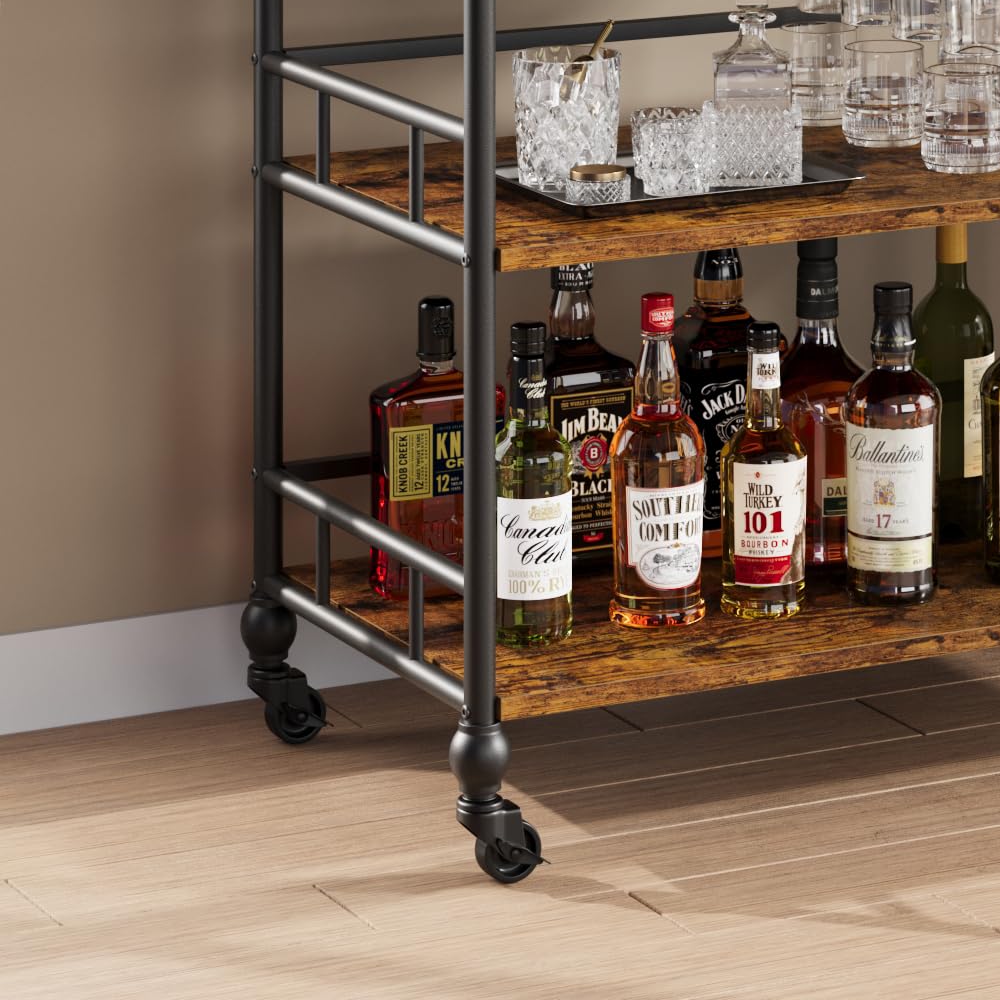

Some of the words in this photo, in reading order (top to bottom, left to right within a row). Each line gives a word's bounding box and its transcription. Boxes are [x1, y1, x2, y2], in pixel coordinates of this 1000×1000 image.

[701, 390, 734, 420] JACK
[561, 414, 586, 443] JIM
[398, 435, 408, 466] CREEK
[436, 430, 462, 460] KN
[590, 447, 599, 459] B
[398, 467, 408, 493] KNOB
[414, 480, 424, 491] 12
[436, 474, 450, 493] 12
[747, 482, 774, 496] WILD
[826, 485, 848, 497] DAL
[743, 492, 783, 509] TURKEY
[500, 513, 570, 540] Canad
[743, 510, 784, 534] 101
[876, 513, 891, 529] 17
[741, 539, 789, 549] BOURBON
[508, 580, 545, 594] 100%
